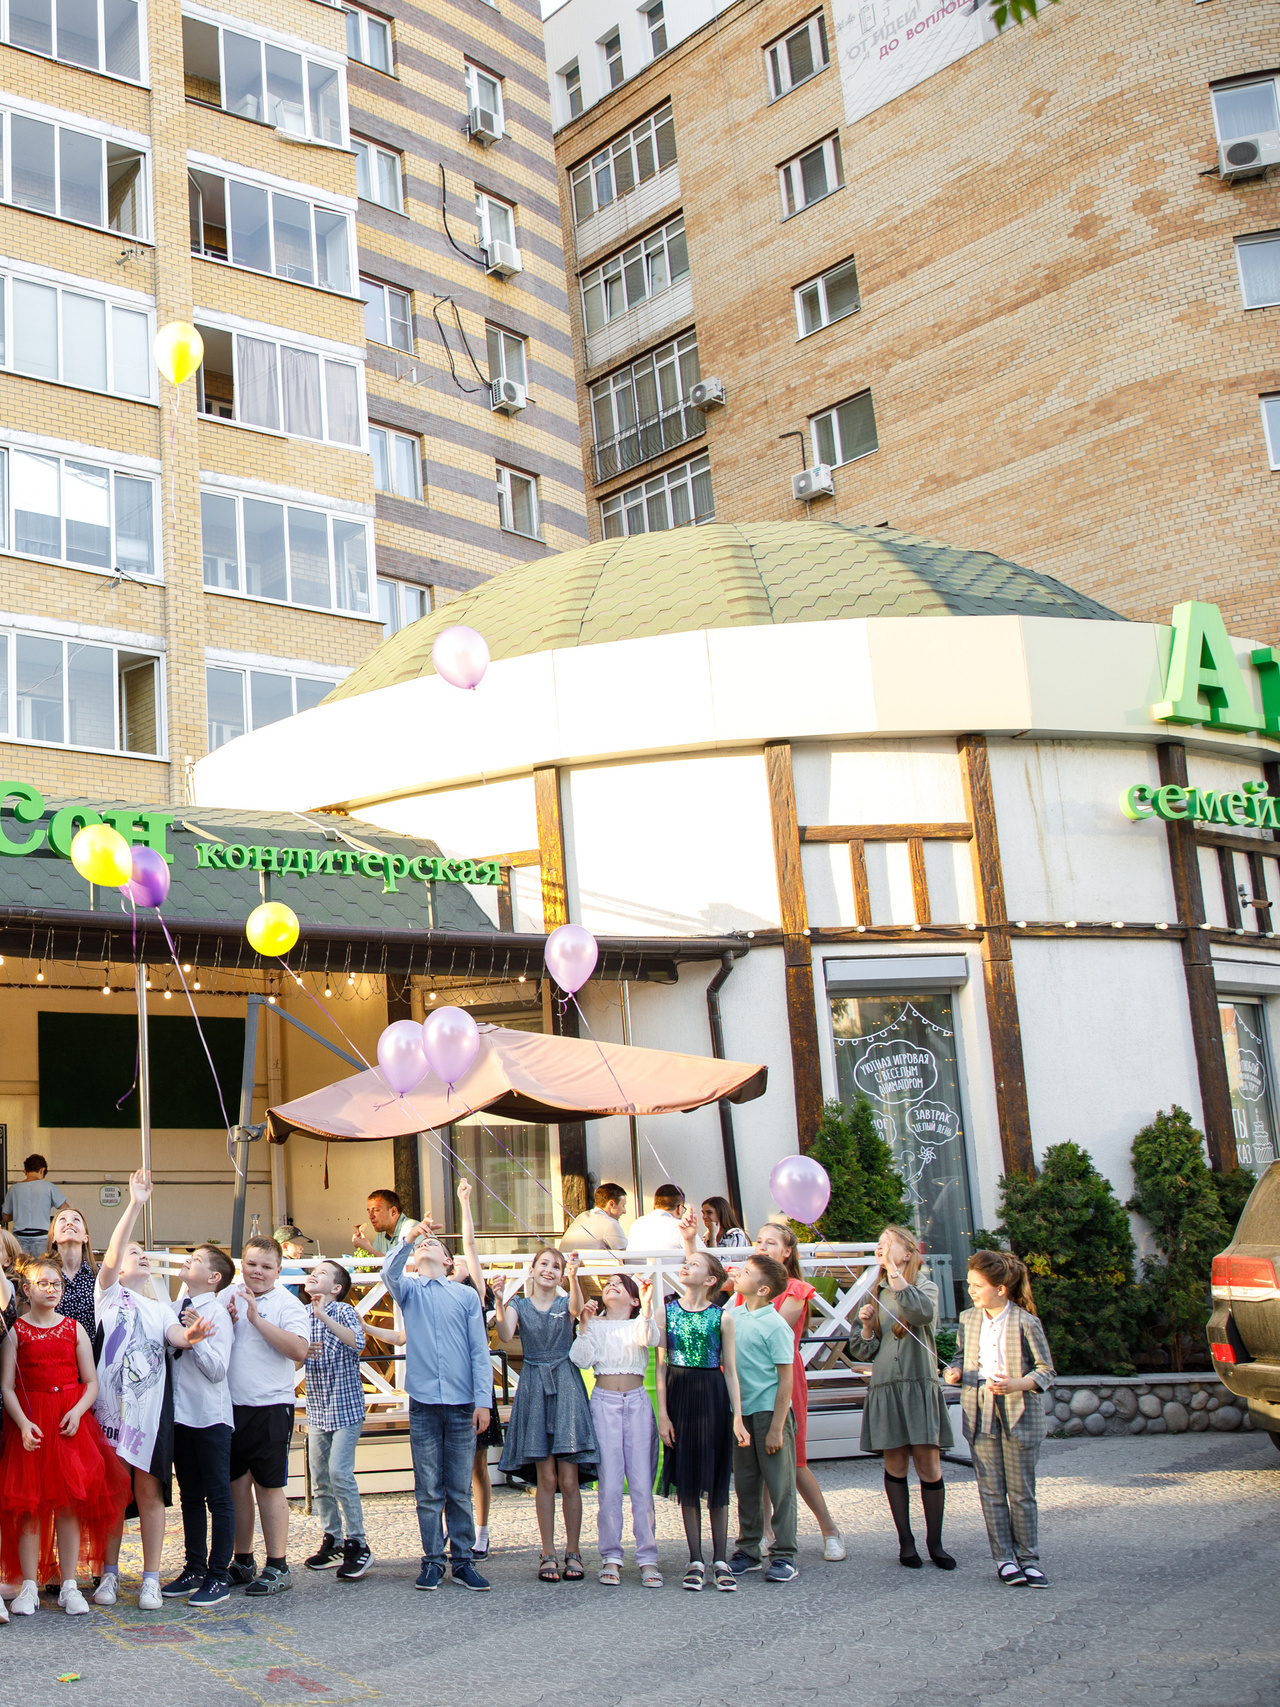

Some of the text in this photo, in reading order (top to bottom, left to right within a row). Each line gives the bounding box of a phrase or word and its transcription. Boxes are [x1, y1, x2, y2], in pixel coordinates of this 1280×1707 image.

[879, 39, 900, 60] ДО
[1152, 600, 1280, 743] А
[195, 842, 504, 894] кондитерская
[860, 1053, 930, 1076] УЮТНАЯ ИГРОВАЯ
[874, 1072, 883, 1083] С
[878, 1078, 924, 1095] АНИМАТОРОМ
[913, 1109, 952, 1124] ЗАВТРАК
[913, 1121, 952, 1137] ЦЕЛЫЙ ДЕНЬ
